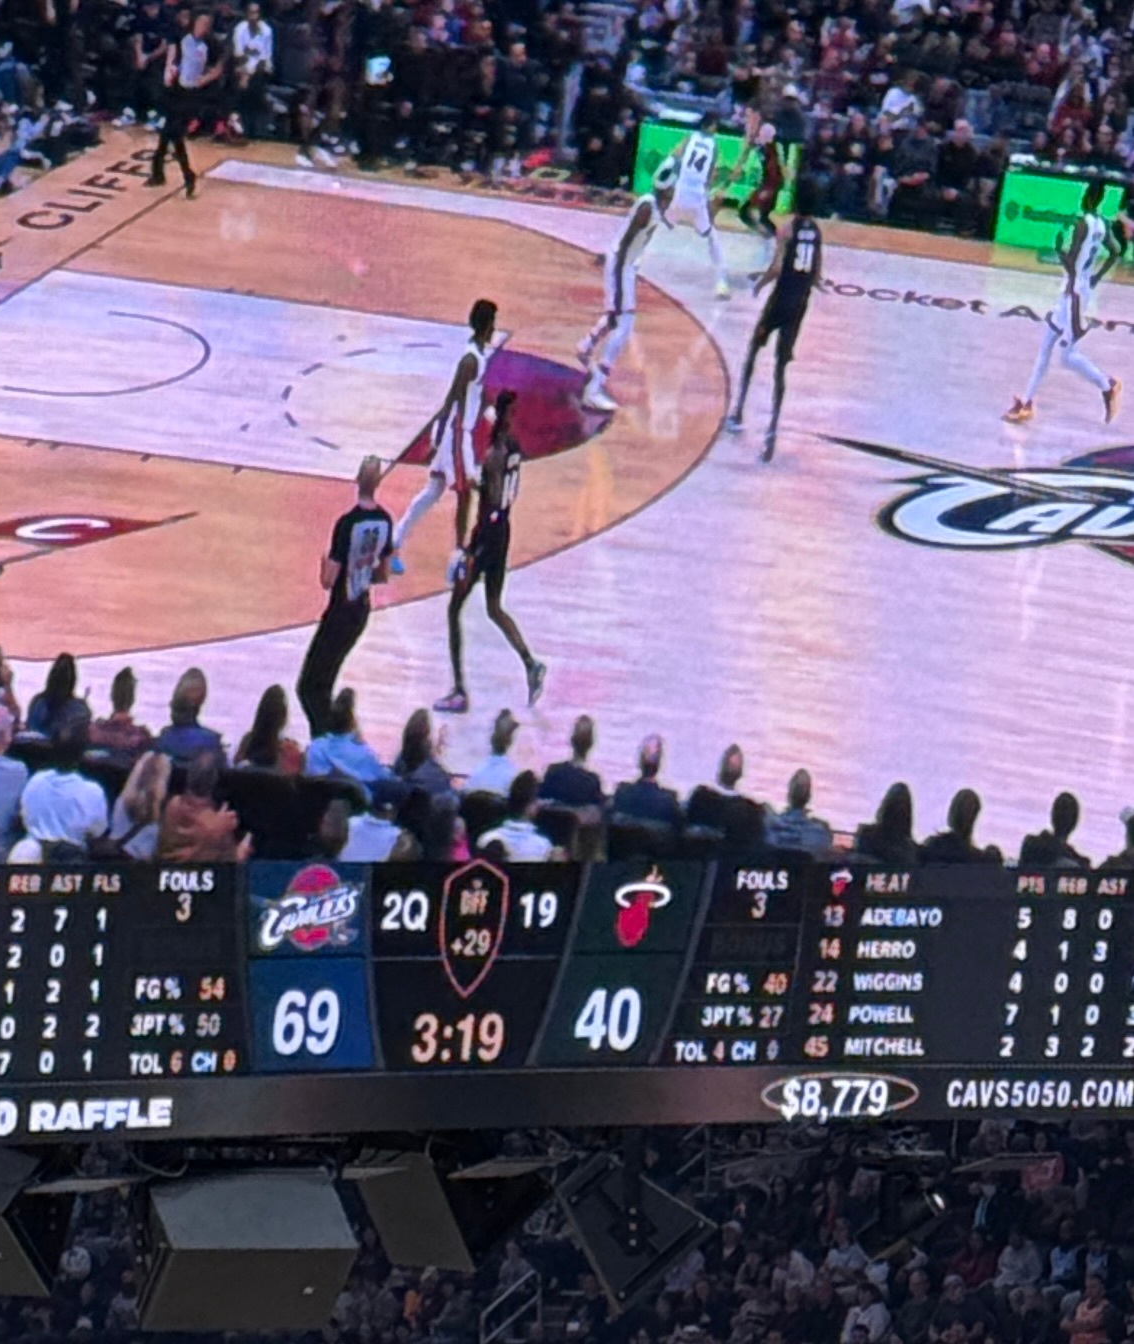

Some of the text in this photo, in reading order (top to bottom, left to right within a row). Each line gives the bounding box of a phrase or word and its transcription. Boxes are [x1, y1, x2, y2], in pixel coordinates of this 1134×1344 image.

[8, 874, 41, 893] REB
[50, 874, 83, 893] AST
[92, 874, 121, 893] FLS
[159, 871, 214, 891] FOULS
[736, 870, 788, 890] FOULS
[866, 874, 910, 893] HEAT
[1018, 876, 1045, 894] PTS
[175, 893, 193, 922] 3
[381, 891, 428, 931] 2Q
[519, 891, 558, 928] 19
[751, 892, 768, 919] 3
[823, 906, 1113, 929] 13 ADEBAYO 5 8 0
[10, 909, 26, 932] 2
[54, 908, 68, 932] 7
[96, 908, 107, 932] 1
[451, 930, 491, 956] +29
[819, 938, 1108, 961] 14 HERRO 4 1 3
[6, 946, 22, 968] 2
[49, 944, 65, 967] 0
[93, 944, 103, 966] 1
[3, 980, 14, 1004] 1
[45, 979, 61, 1003] 2
[89, 979, 99, 1003] 1
[134, 977, 160, 999] FG
[705, 972, 731, 993] FG
[812, 971, 1104, 994] 22 WIGGINS 4 0 0
[129, 1014, 165, 1036] 3PT
[273, 989, 340, 1055] 69
[574, 986, 641, 1052] 40
[807, 1003, 1100, 1025] 24 POWELL 7 1 0
[0, 1016, 16, 1040] 0
[41, 1015, 57, 1039] 2
[84, 1014, 100, 1038] 2
[412, 1012, 504, 1063] 3:19
[674, 1042, 707, 1062] TOL
[731, 1041, 756, 1061] CH
[803, 1037, 830, 1057] 45
[843, 1037, 925, 1056] MITCHELL
[999, 1036, 1014, 1057] 2
[1045, 1036, 1059, 1057] 3
[1080, 1036, 1095, 1057] 2
[38, 1051, 54, 1074] 0
[82, 1050, 93, 1073] 1
[129, 1053, 163, 1075] TOL
[190, 1051, 217, 1073] CH
[780, 1077, 1134, 1124] $8,779 CAVS5050.COM
[29, 1098, 173, 1132] RAFFLE
